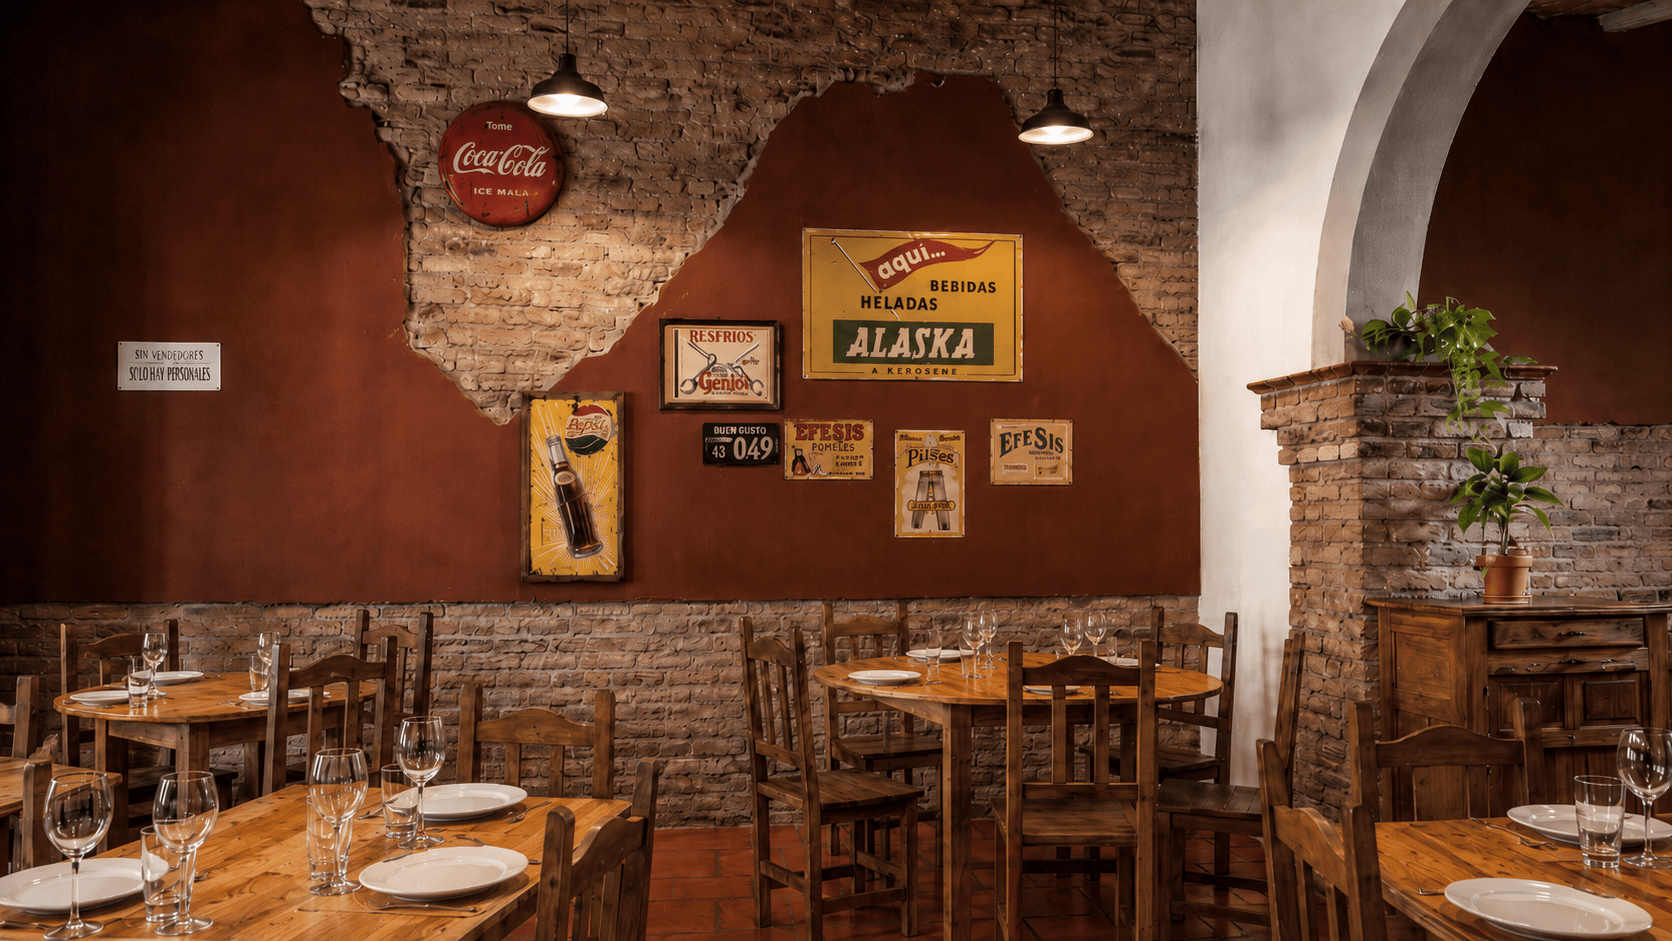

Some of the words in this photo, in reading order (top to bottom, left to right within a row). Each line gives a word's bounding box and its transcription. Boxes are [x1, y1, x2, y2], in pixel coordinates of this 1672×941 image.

[486, 121, 513, 131] Tome
[453, 141, 550, 177] Coca-Cola
[473, 187, 493, 196] ICE
[497, 188, 529, 197] MALA
[930, 279, 997, 294] BEBIDAS
[860, 295, 938, 311] HELADAS
[689, 329, 754, 343] RESFRIOS
[846, 326, 975, 360] ALASKA
[135, 349, 149, 360] SIN
[151, 350, 204, 361] VENDEDORES
[167, 366, 211, 381] PERSONALES
[887, 367, 958, 375] KEROSENE
[713, 426, 737, 435] BUEN
[738, 426, 767, 435] GUSTO
[794, 423, 865, 441] EFESIS
[711, 445, 726, 459] 43
[812, 443, 855, 452] POMELES
